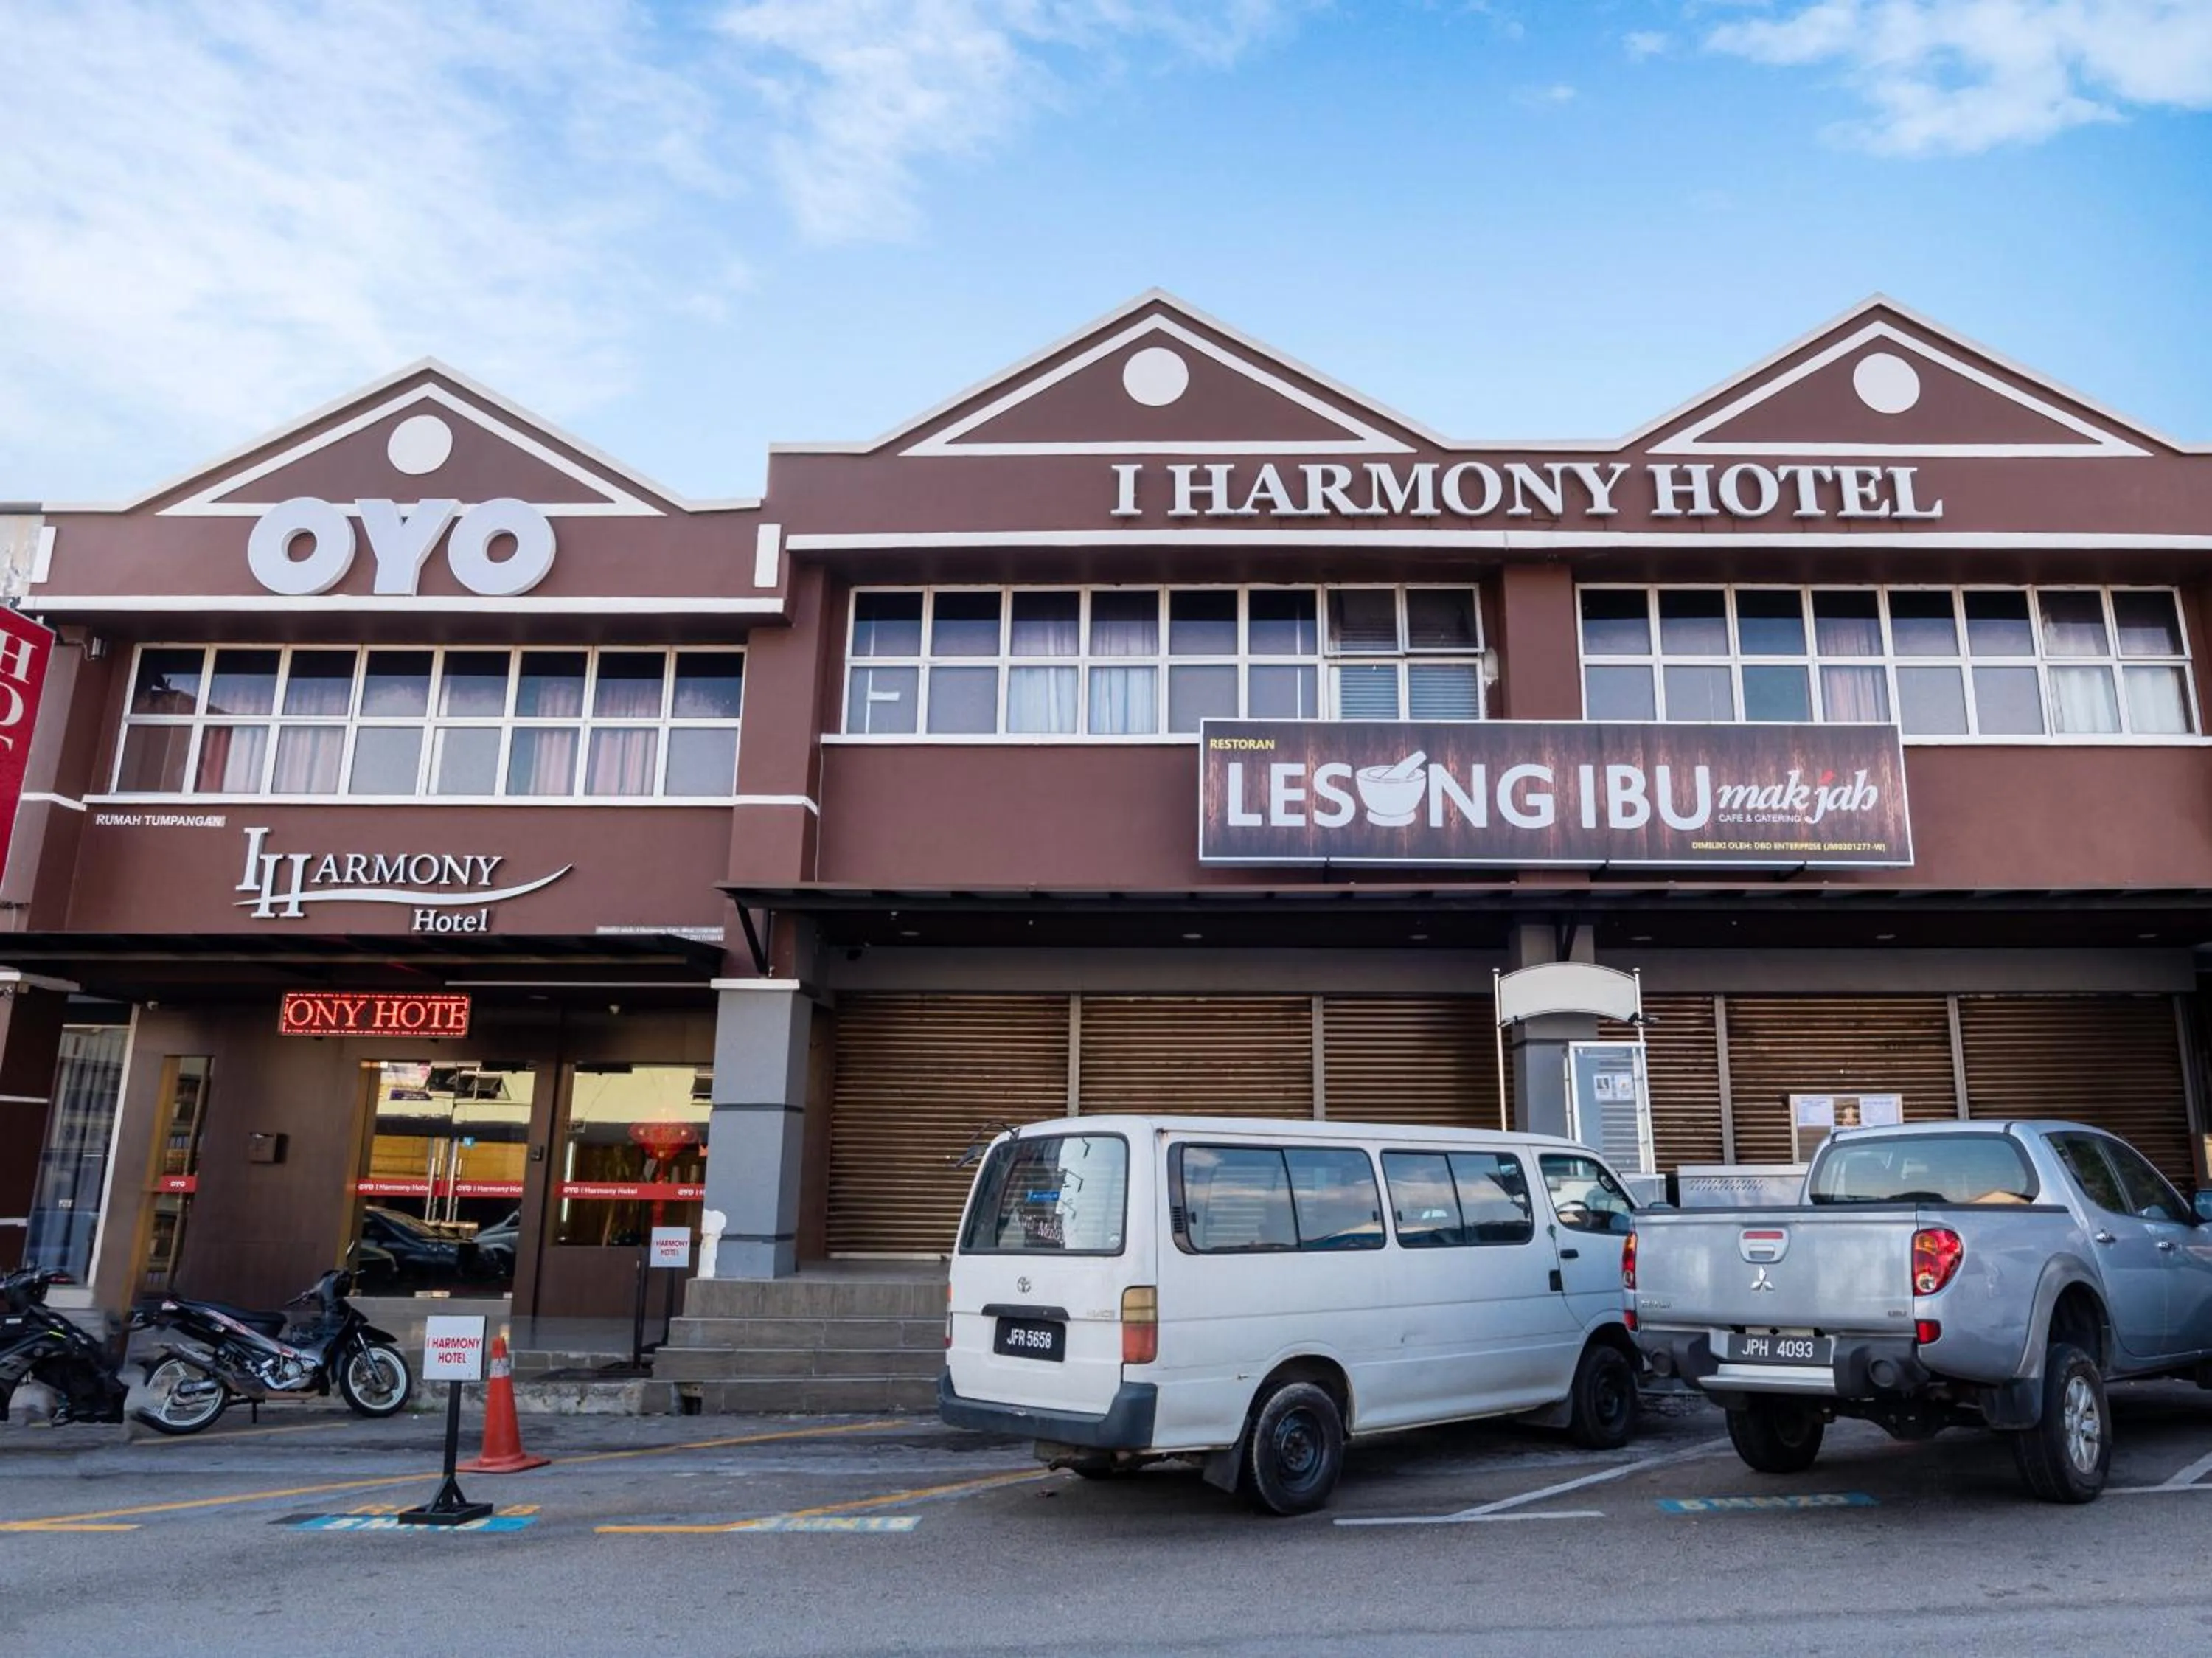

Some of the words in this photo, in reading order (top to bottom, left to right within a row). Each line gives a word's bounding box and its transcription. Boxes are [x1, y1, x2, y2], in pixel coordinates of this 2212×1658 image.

[1110, 464, 1143, 515] I
[1167, 462, 1631, 516] HARMONY
[1646, 462, 1943, 518] HOTEL
[248, 496, 557, 595] OYO
[1210, 739, 1275, 750] RESTORAN
[1579, 764, 1711, 830] IBU
[1717, 769, 1809, 810] mak
[1804, 769, 1878, 824] jah
[96, 814, 142, 825] RUMAH
[145, 815, 225, 827] TUMPANGAN
[1719, 814, 1743, 822] CAFE
[1745, 814, 1752, 822] &
[1754, 814, 1801, 823] CATERING
[1774, 842, 1822, 850] ENTERPRISE
[413, 909, 487, 932] Hotel
[288, 999, 366, 1027] ONY
[432, 1337, 481, 1348] HARMONY
[1007, 1328, 1025, 1346] JFR
[1026, 1331, 1052, 1348] 5658
[438, 1352, 467, 1363] HOTEL
[1742, 1339, 1769, 1356] JPH
[1777, 1339, 1814, 1358] 4093
